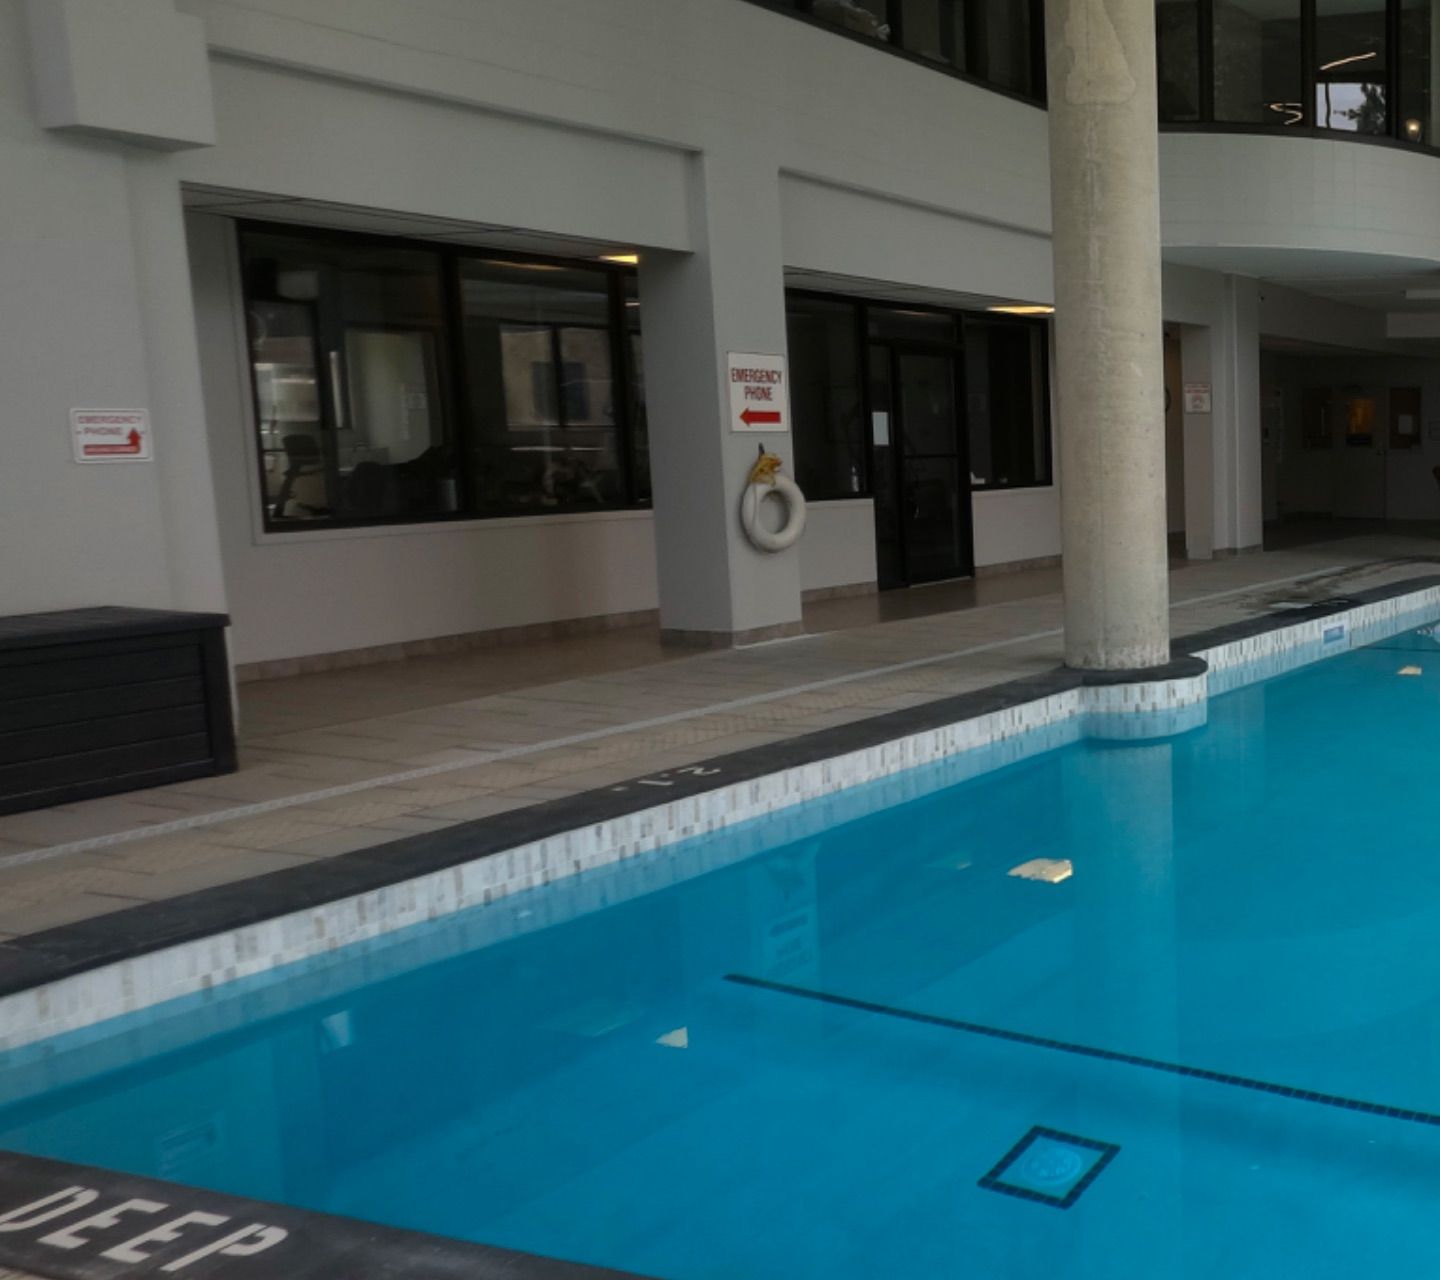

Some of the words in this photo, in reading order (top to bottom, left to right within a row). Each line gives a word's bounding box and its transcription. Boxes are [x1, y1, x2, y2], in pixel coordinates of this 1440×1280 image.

[731, 367, 782, 384] EMERGENCY
[744, 385, 773, 401] PHONE
[0, 1185, 289, 1272] DEEP
